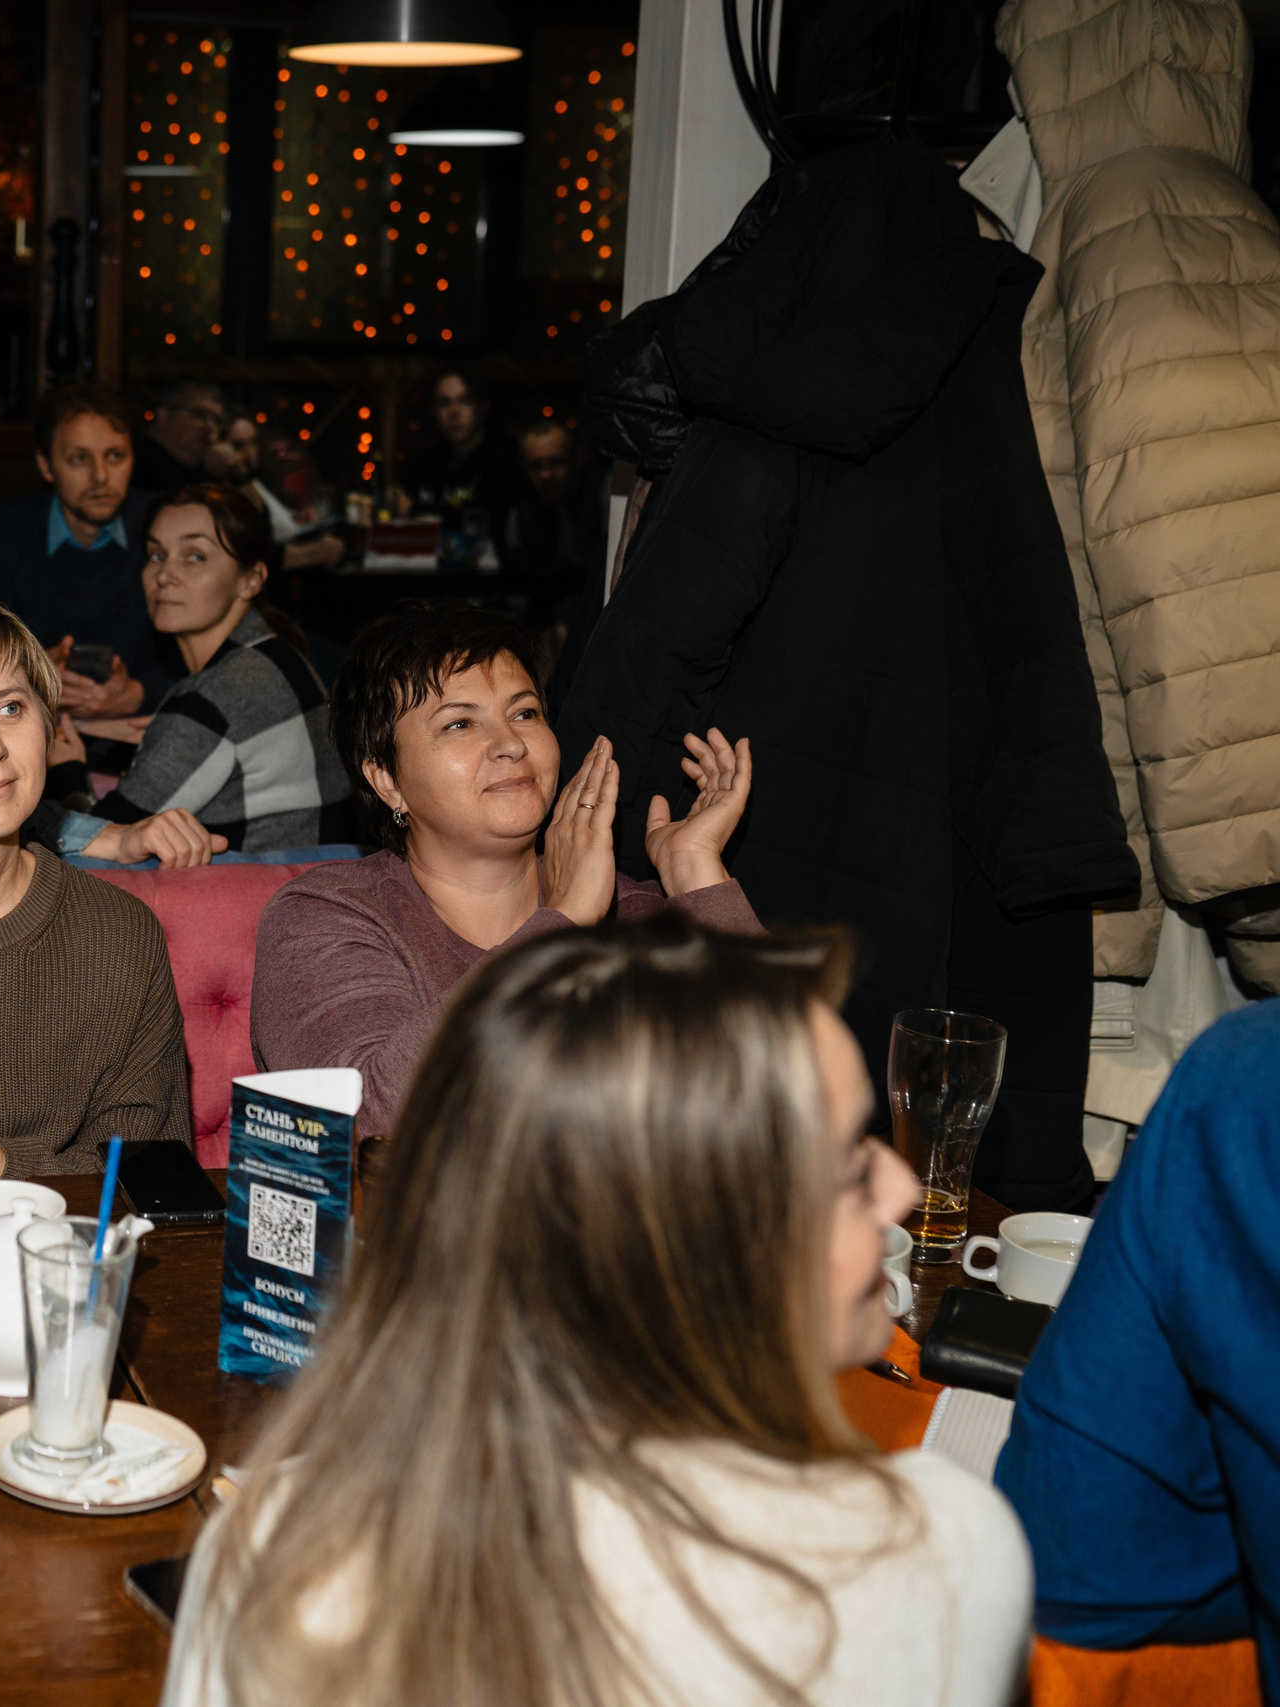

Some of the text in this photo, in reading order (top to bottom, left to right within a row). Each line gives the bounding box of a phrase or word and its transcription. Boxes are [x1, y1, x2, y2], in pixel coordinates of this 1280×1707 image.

[245, 1103, 295, 1131] СТАНЬ
[245, 1120, 319, 1154] КЛИЕНТОМ
[255, 1276, 305, 1304] БОНУСЫ
[251, 1339, 301, 1368] СКИДКА
